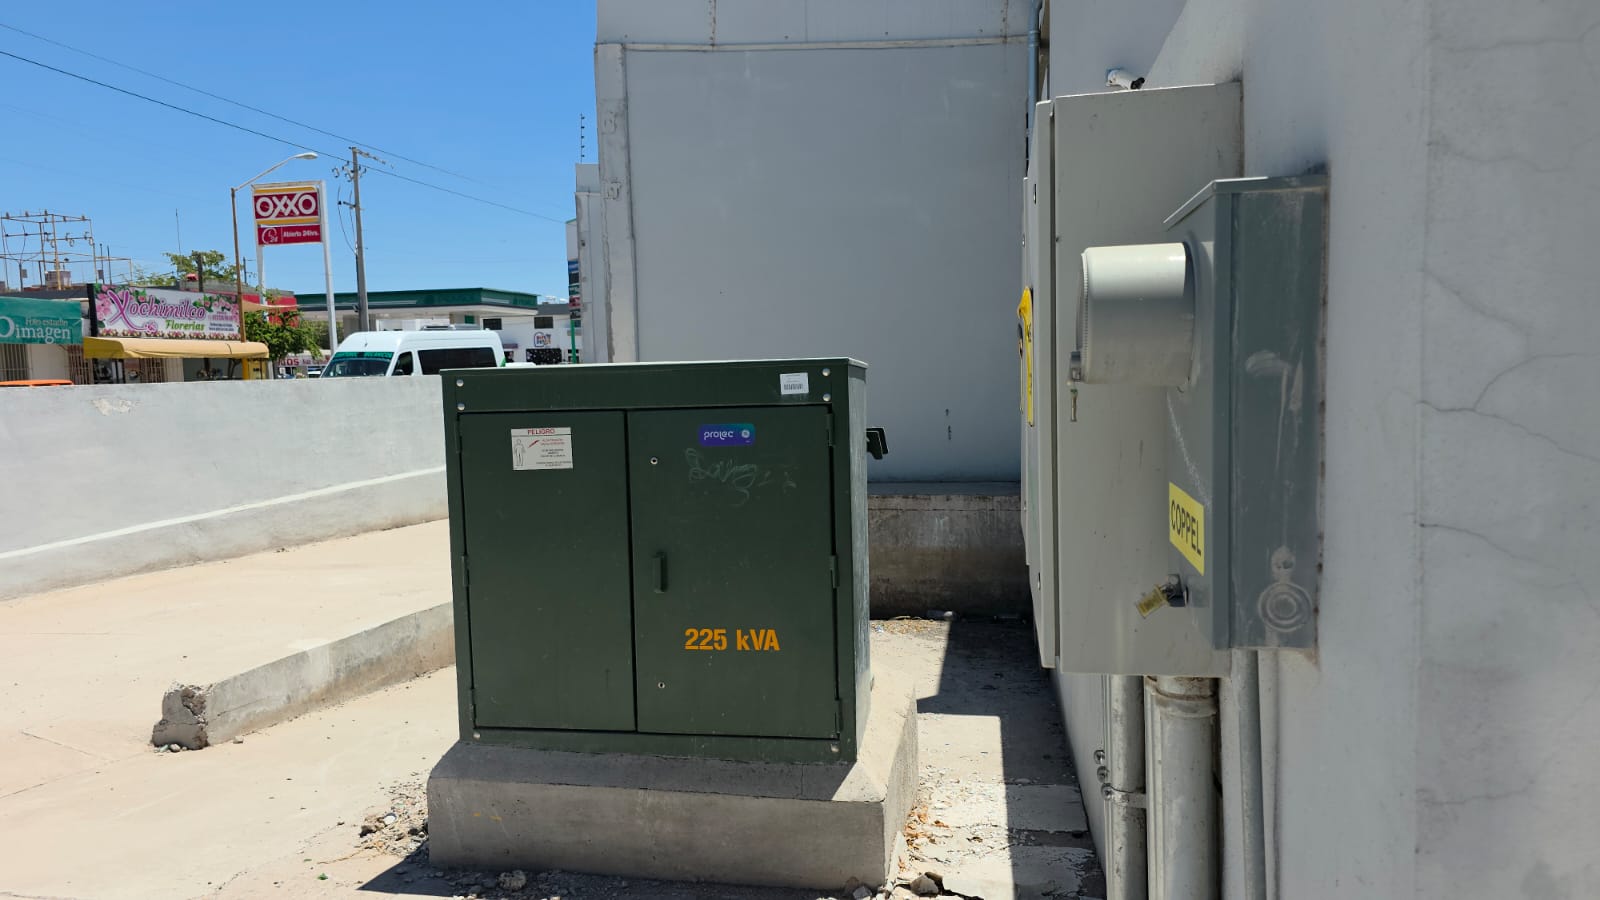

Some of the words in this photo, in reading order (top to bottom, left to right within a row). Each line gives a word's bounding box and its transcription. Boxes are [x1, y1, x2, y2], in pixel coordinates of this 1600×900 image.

[256, 193, 316, 218] OXXO
[107, 290, 206, 331] Xochimilco
[1171, 499, 1202, 557] COPPEL
[684, 628, 728, 651] 225
[735, 628, 780, 651] kVA
